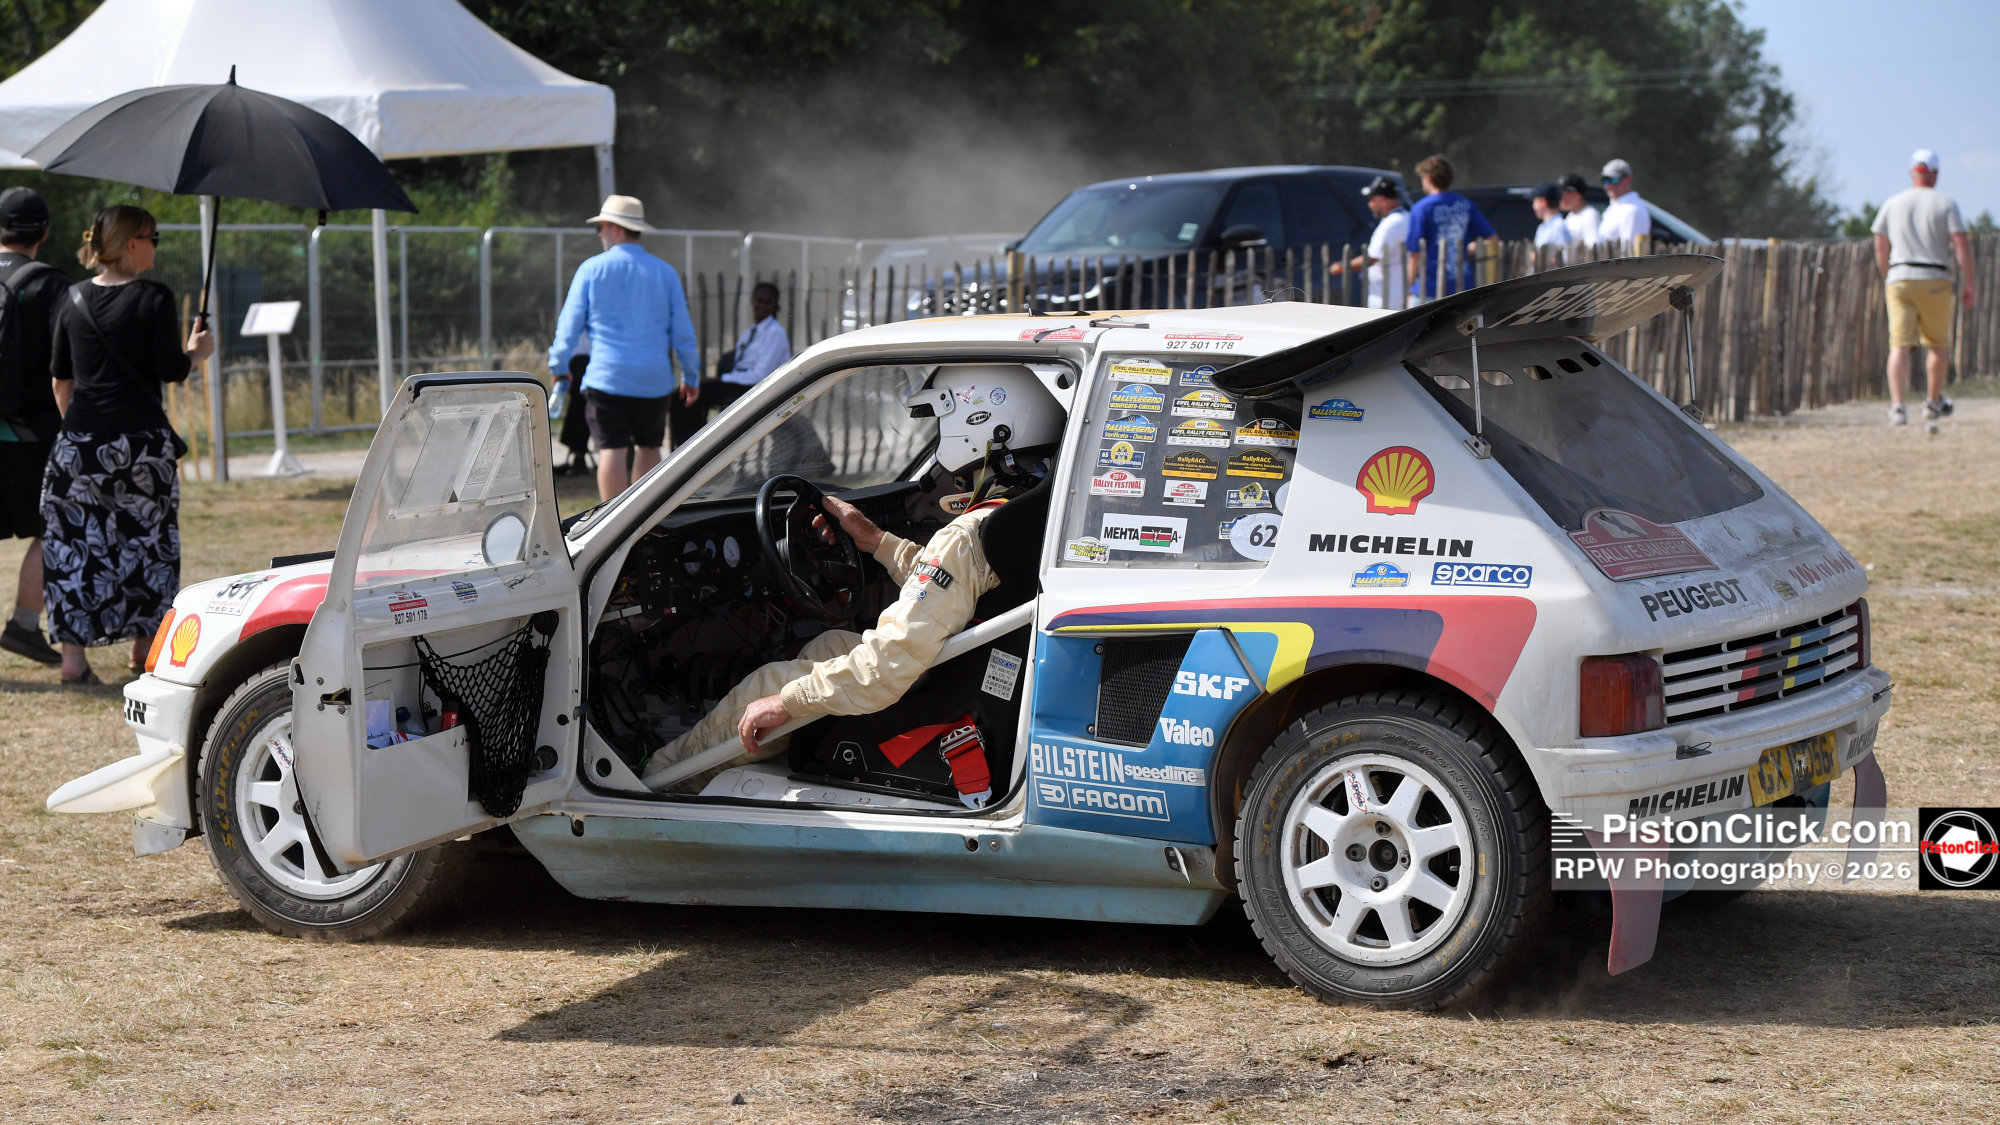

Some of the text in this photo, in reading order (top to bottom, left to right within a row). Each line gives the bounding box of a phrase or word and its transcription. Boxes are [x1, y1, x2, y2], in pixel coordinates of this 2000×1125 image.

[1166, 341, 1235, 350] 927 501 178
[1111, 394, 1163, 404] RALLYLEGEND
[1310, 408, 1363, 418] RALLYLEGEND
[1105, 423, 1156, 434] RALLYLEGEND
[1177, 456, 1207, 464] RallyRACC
[1242, 455, 1272, 464] RallyRACC
[1093, 478, 1141, 489] RALLYE FESTIVAL
[1103, 526, 1140, 541] MEHTA
[1249, 524, 1278, 548] 62
[1308, 533, 1473, 557] MICHELIN
[1069, 543, 1091, 551] Historic
[1591, 541, 1697, 564] RALLYE SANREMO
[916, 562, 950, 586] MARTINI
[1436, 563, 1530, 586] sparco
[1639, 578, 1748, 622] PEUGEOT
[394, 609, 427, 625] 927 501 178
[1173, 670, 1250, 700] SKF
[1159, 717, 1215, 747] Valeo
[1031, 743, 1198, 784] BILSTEIN speedline
[1072, 787, 1164, 815] FACOM
[1627, 774, 1745, 821] MICHELIN
[245, 874, 346, 919] PIRELLI
[1260, 886, 1357, 982] PIRELLI
